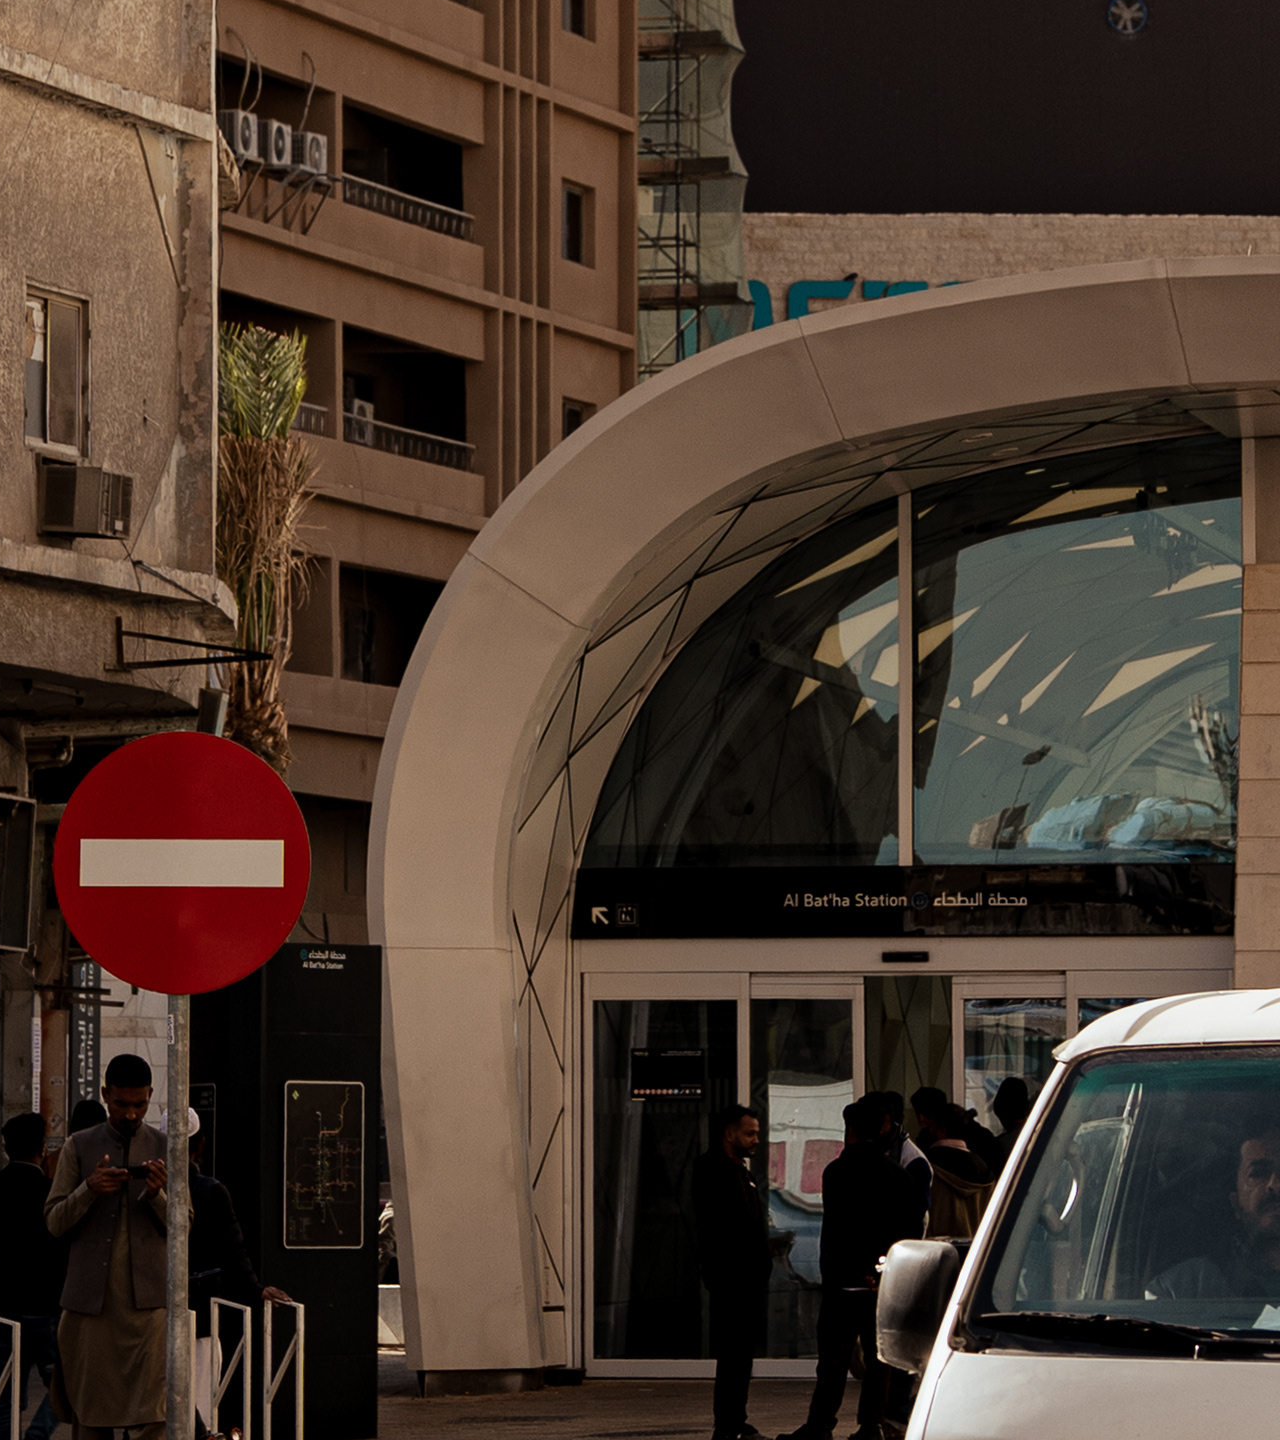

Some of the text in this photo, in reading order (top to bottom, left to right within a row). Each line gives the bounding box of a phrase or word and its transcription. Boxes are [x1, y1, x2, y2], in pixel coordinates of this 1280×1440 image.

[783, 893, 908, 908] Al Bat'ha Station
[933, 891, 1028, 910] محطة البطحاء
